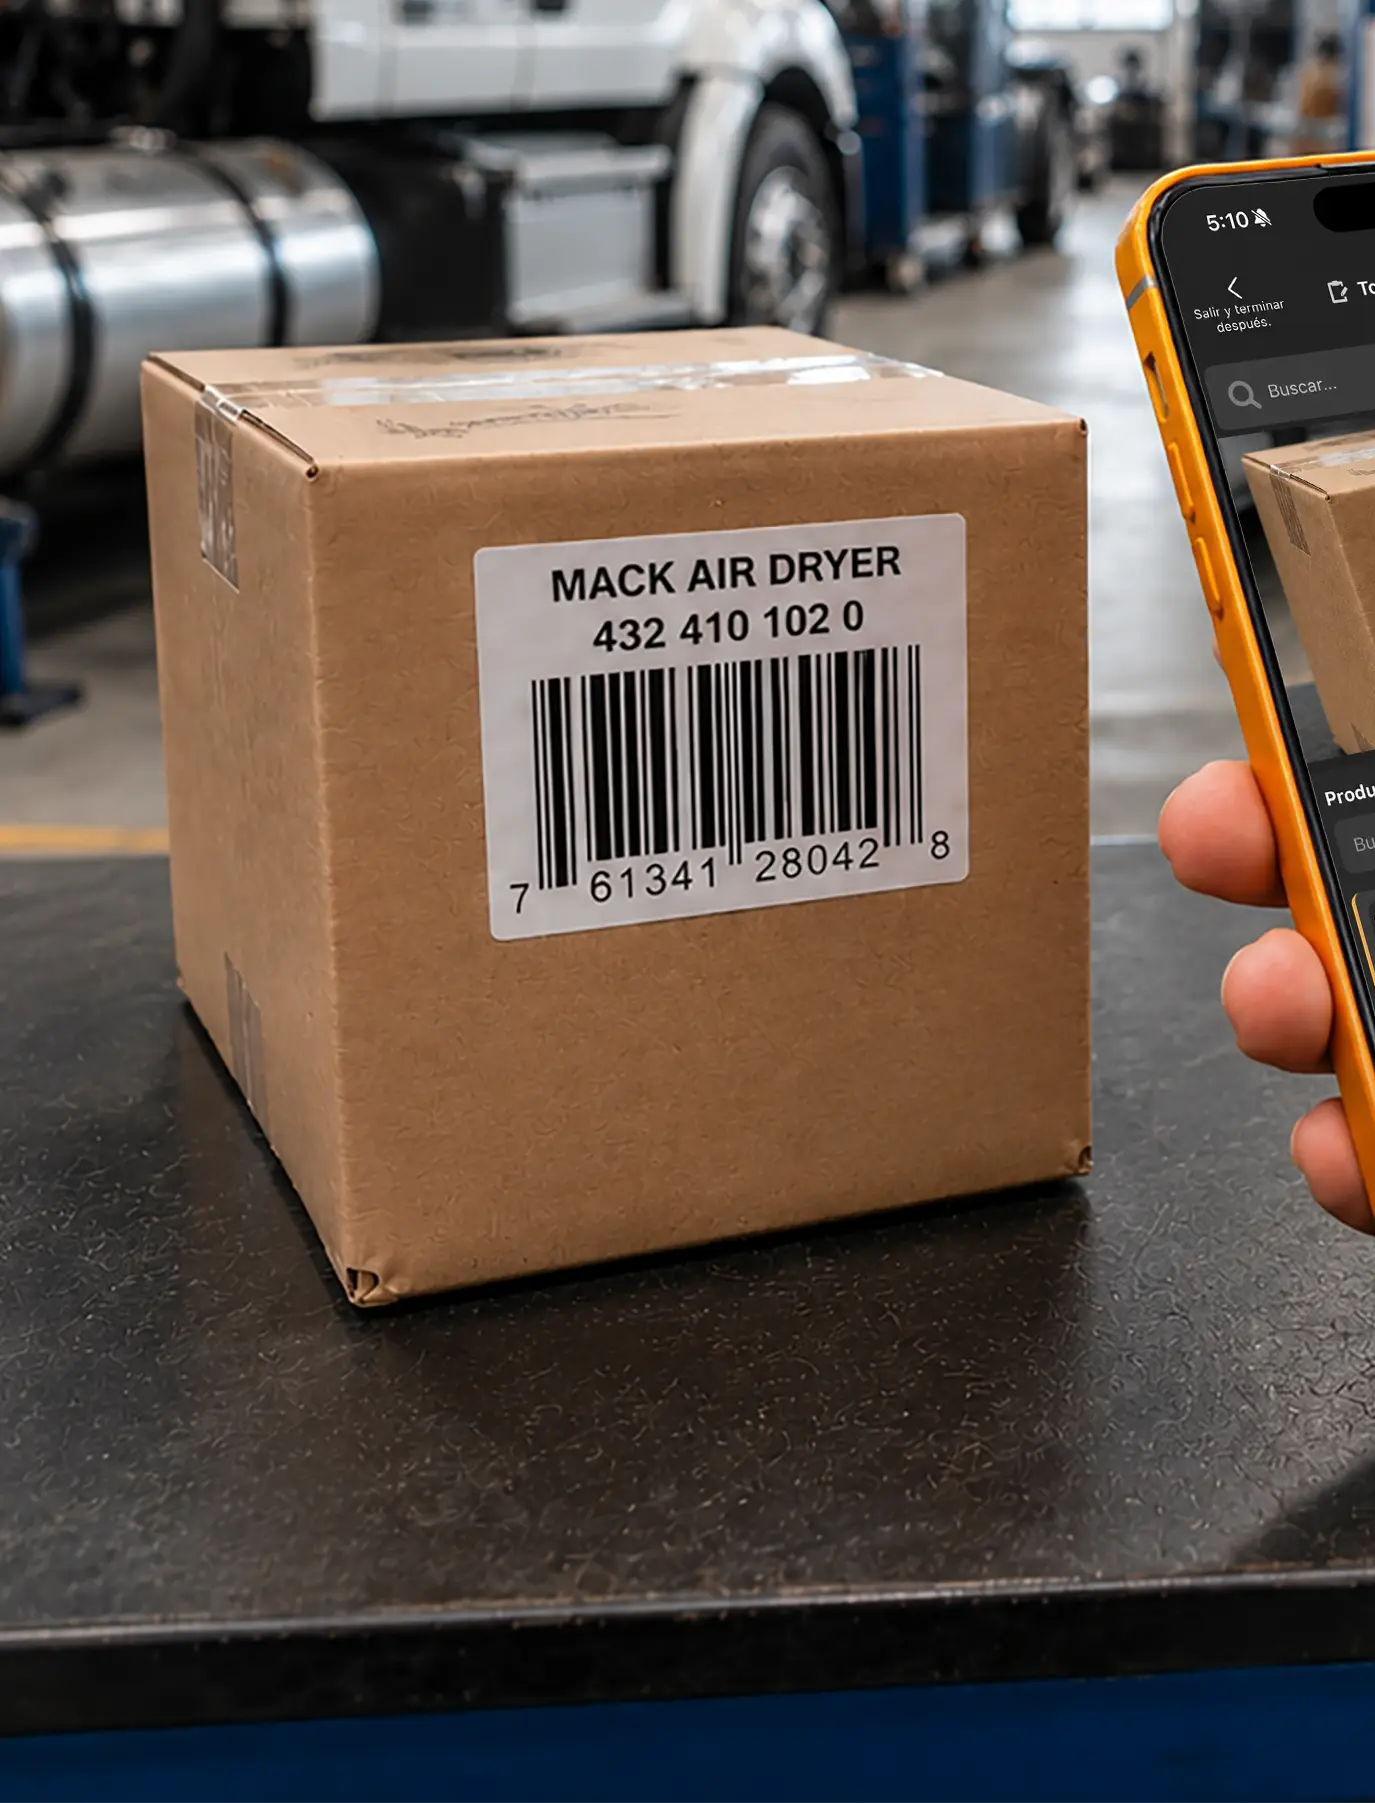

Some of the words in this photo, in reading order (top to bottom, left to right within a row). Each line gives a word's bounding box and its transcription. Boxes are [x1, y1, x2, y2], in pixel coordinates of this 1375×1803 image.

[1206, 210, 1249, 232] 5:10
[1194, 304, 1222, 320] Salir
[1225, 306, 1232, 317] y
[1235, 300, 1285, 315] terminar
[1216, 317, 1272, 334] después.
[1267, 378, 1337, 399] Buscar...
[551, 561, 675, 602] MACK
[688, 557, 756, 592] AIR
[769, 546, 901, 585] DRYER
[593, 619, 665, 652] 432
[680, 610, 749, 644] 410
[763, 604, 829, 637] 102
[843, 601, 863, 631] 0
[509, 883, 530, 913] 7
[591, 858, 716, 902] 61341
[755, 838, 880, 882] 28042
[930, 831, 950, 858] 8
